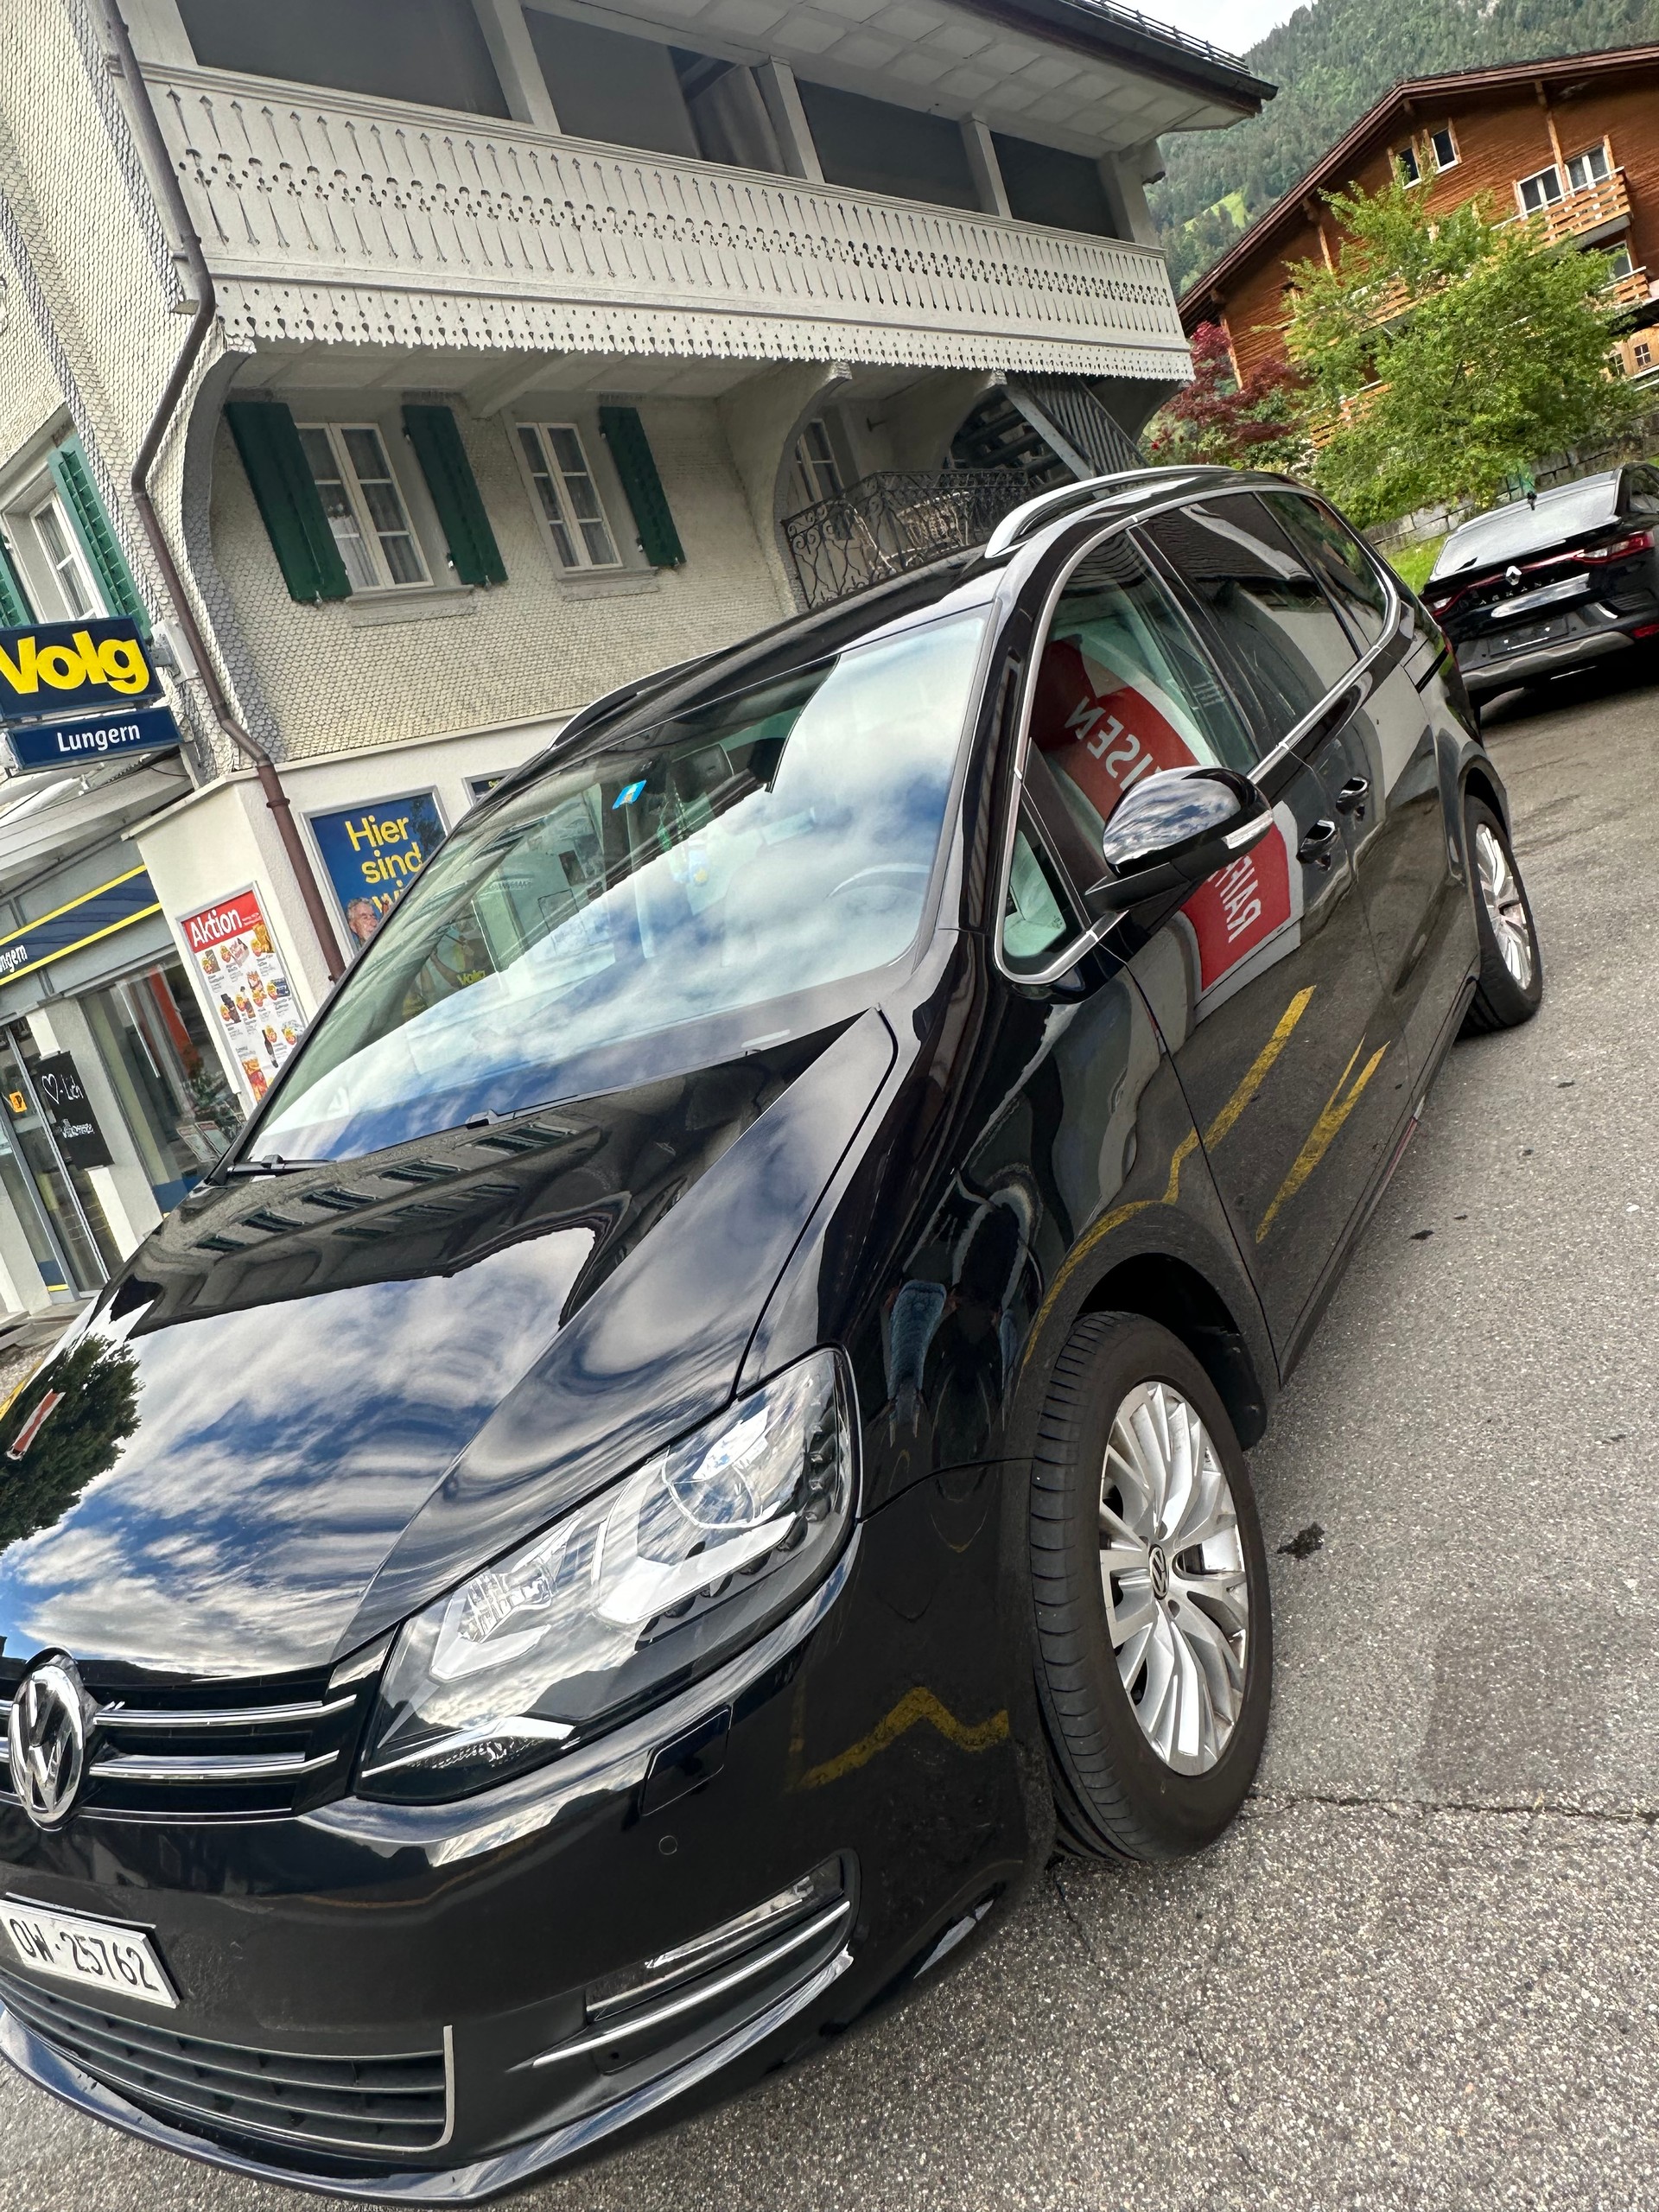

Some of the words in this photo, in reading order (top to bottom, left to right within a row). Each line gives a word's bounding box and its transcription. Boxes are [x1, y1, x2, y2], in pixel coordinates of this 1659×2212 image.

[0, 630, 150, 695] Volg
[56, 724, 141, 752] Lungern
[345, 815, 410, 851] Hier
[360, 842, 424, 884] sind
[190, 909, 243, 948] Aktion
[0, 944, 29, 973] ngern
